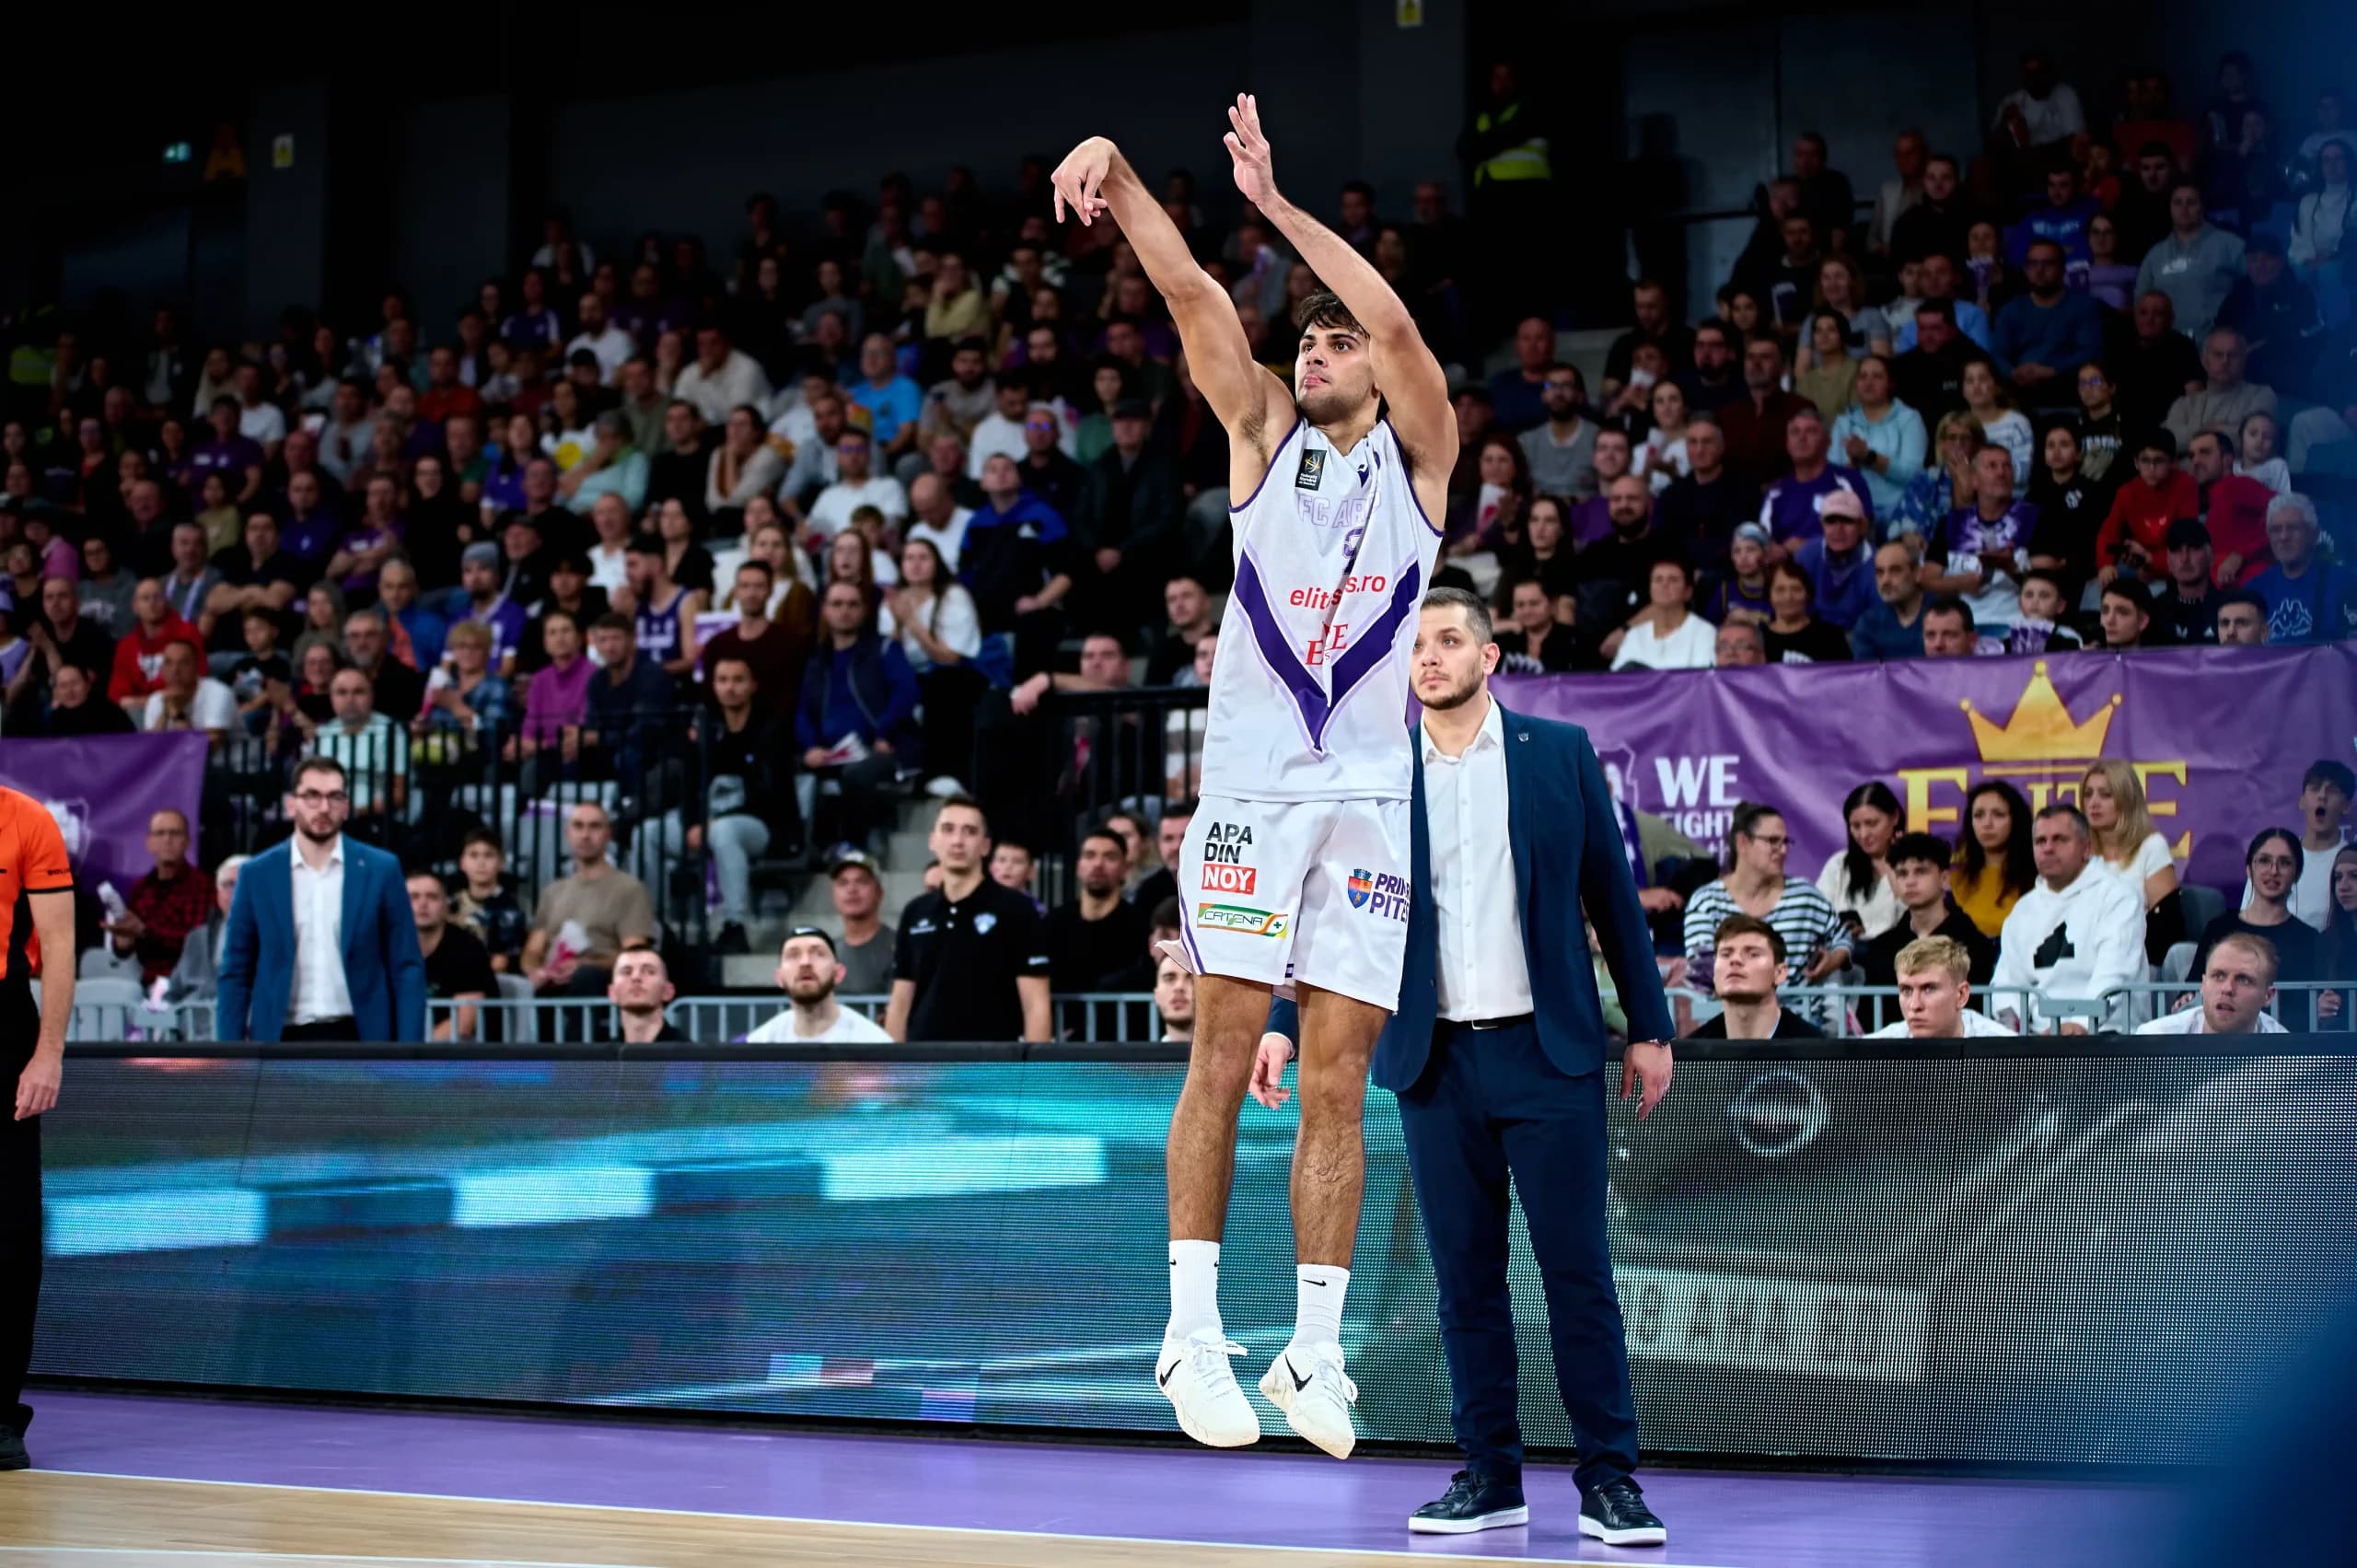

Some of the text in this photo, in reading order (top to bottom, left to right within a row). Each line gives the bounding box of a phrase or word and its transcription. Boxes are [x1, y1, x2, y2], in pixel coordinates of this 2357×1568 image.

[1298, 493, 1331, 527] FC
[1655, 755, 1741, 807] WE
[1206, 821, 1253, 845] APA
[1204, 842, 1242, 864] DIN
[1203, 865, 1253, 891] NOY
[1204, 911, 1263, 926] CATENA
